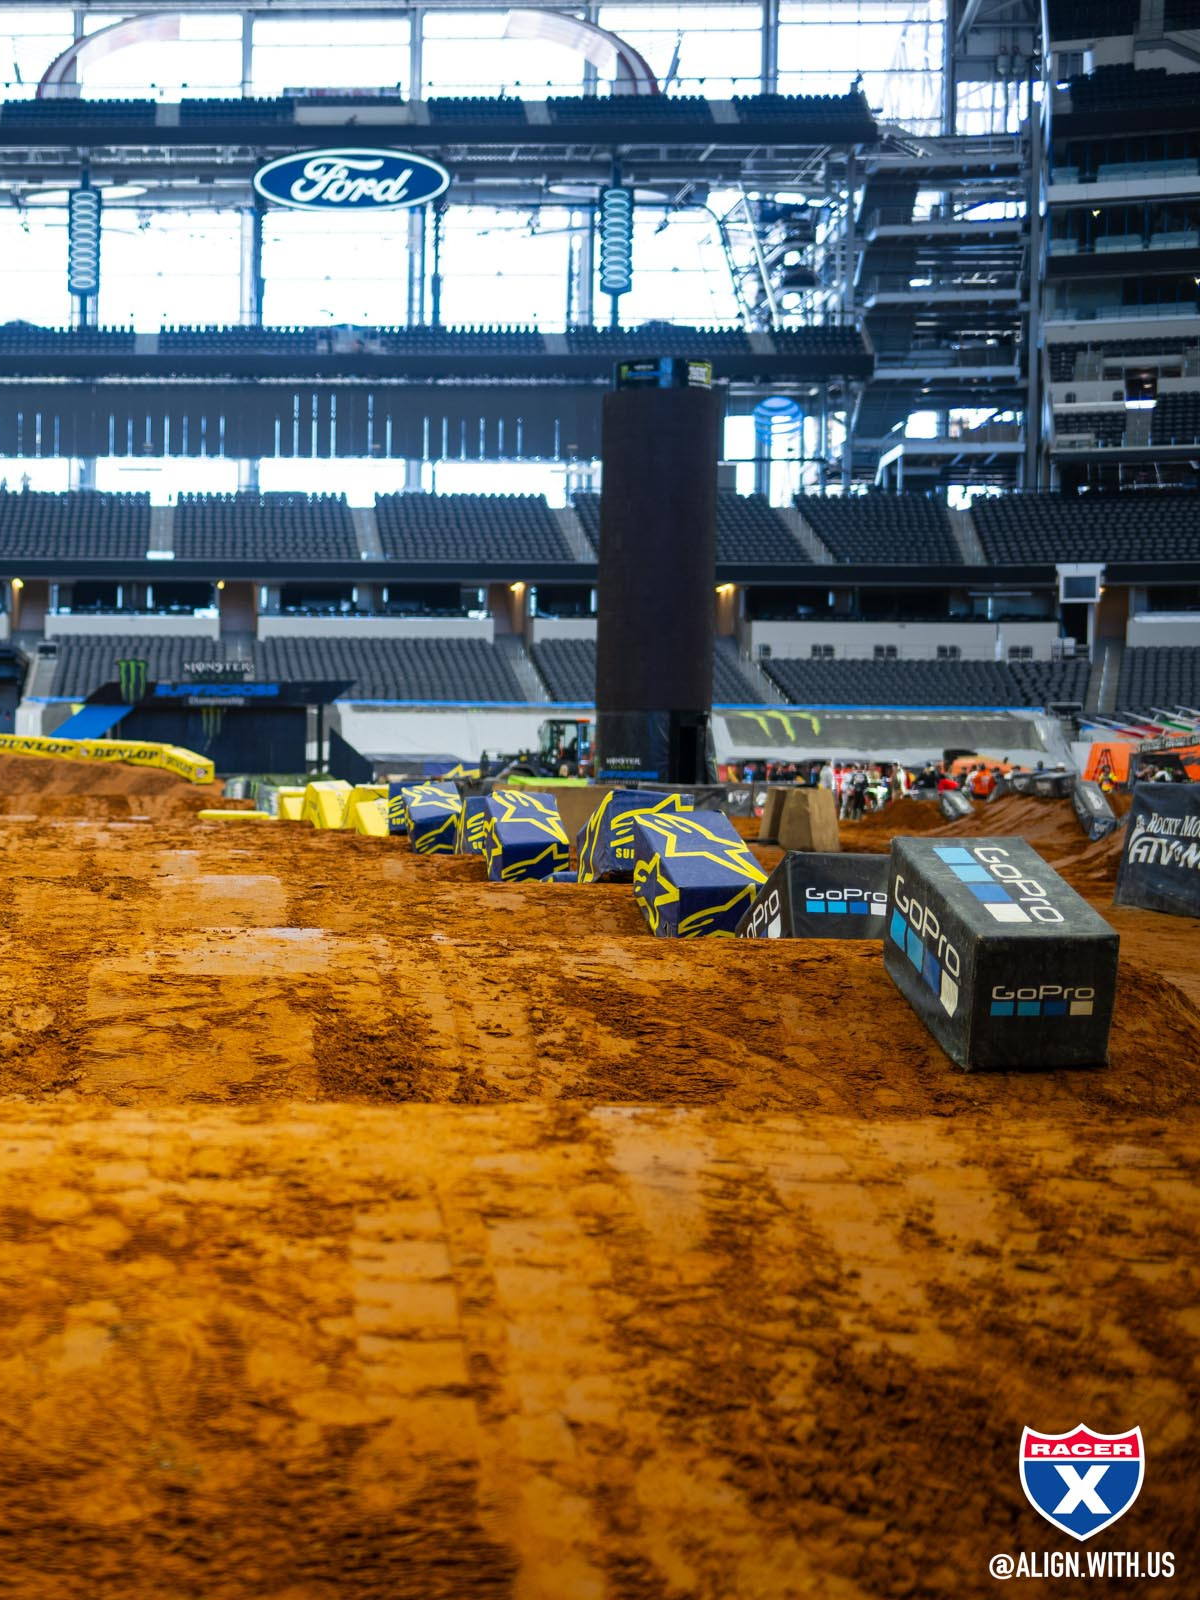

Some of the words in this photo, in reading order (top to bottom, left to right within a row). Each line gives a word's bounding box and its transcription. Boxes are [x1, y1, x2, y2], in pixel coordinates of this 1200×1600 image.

[290, 157, 414, 202] Ford
[94, 747, 159, 760] DUNLOP
[1146, 812, 1182, 835] ROCKY
[805, 886, 887, 903] GoPro
[974, 846, 1065, 922] GoPro
[740, 889, 780, 938] oPro
[895, 874, 960, 978] GoPro
[991, 984, 1096, 1001] GoPro
